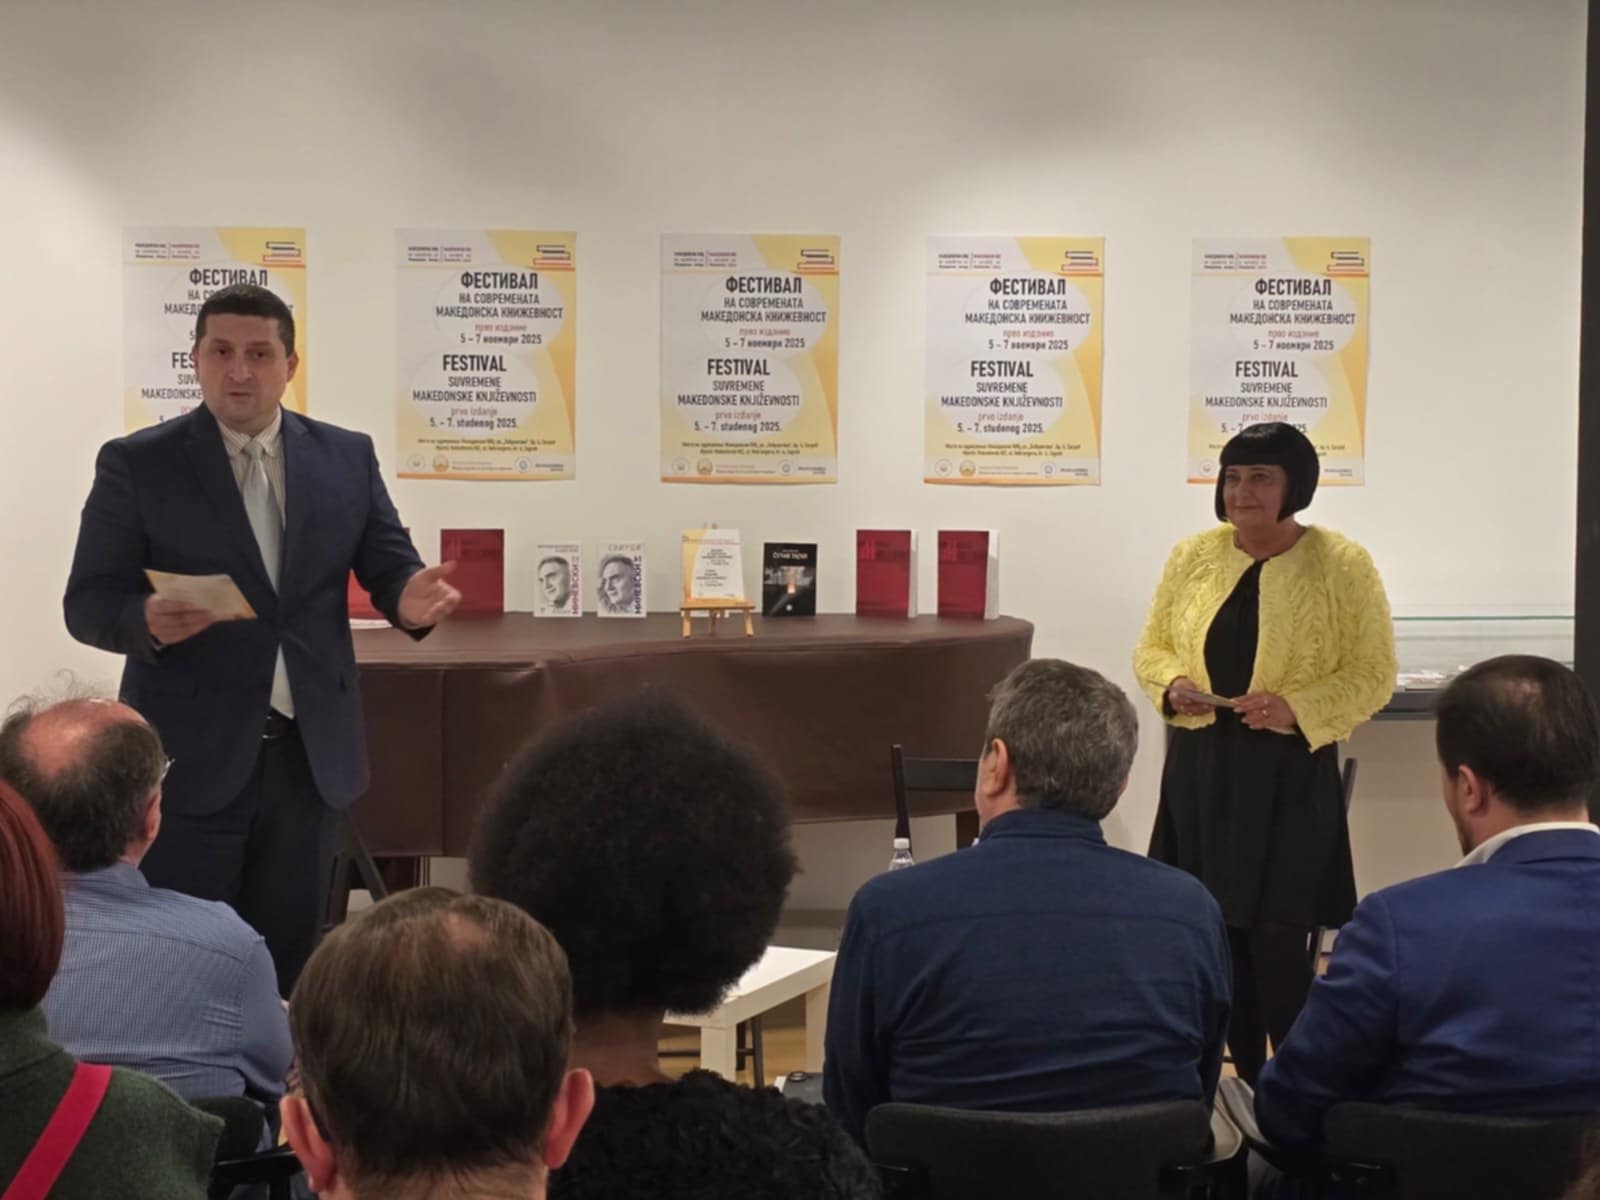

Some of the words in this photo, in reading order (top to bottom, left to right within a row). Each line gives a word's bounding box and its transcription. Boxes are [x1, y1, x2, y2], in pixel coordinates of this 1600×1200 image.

[190, 269, 268, 286] ФЕСТИВАЛ
[460, 272, 538, 289] ФЕСТИВАЛ
[726, 276, 802, 293] ФЕСТИВАЛ
[990, 278, 1066, 295] ФЕСТИВАЛ
[1255, 278, 1331, 295] ФЕСТИВАЛ
[188, 290, 200, 300] НА
[459, 293, 471, 303] НА
[474, 294, 539, 304] СОВРЕМЕНАТА
[724, 298, 736, 308] НА
[739, 298, 803, 309] СОВРЕМЕНАТА
[988, 300, 999, 310] НА
[1003, 300, 1067, 310] СОВРЕМЕНАТА
[1253, 300, 1265, 310] НА
[1268, 300, 1333, 311] СОВРЕМЕНАТА
[436, 306, 498, 319] МАКЕДОНСКА
[501, 307, 563, 319] КНИЖЕВНОСТ
[701, 311, 762, 323] МАКЕДОНСКА
[765, 311, 826, 323] КНИЖЕВНОСТ
[965, 313, 1026, 325] МАКЕДОНСКА
[1029, 313, 1090, 325] КНИЖЕВНОСТ
[1230, 313, 1291, 325] МАКЕДОНСКА
[1294, 313, 1355, 325] КНИЖЕВНОСТ
[460, 334, 465, 343] 5
[476, 334, 480, 344] 7
[483, 336, 518, 346] ноември
[521, 334, 542, 345] 2025
[725, 338, 730, 348] 5
[741, 338, 745, 348] 7
[748, 340, 782, 350] ноември
[784, 338, 805, 348] 2025
[988, 340, 993, 349] 5
[1004, 340, 1008, 350] 7
[1011, 342, 1045, 352] ноември
[1048, 340, 1068, 350] 2025
[1253, 340, 1259, 350] 5
[1269, 340, 1273, 350] 7
[1276, 342, 1310, 352] ноември
[1313, 340, 1334, 350] 2025
[443, 355, 507, 372] FESTIVAL
[708, 359, 770, 376] FESTIVAL
[971, 360, 1033, 377] FESTIVAL
[1236, 361, 1298, 378] FESTIVAL
[448, 377, 501, 387] SUVREMENE
[713, 381, 764, 392] SUVREMENE
[976, 382, 1028, 393] SUVREMENE
[1241, 382, 1292, 393] SUVREMENE
[142, 388, 202, 399] MAKEDONSKE
[413, 390, 473, 402] MAKEDONSKE
[475, 389, 536, 403] KNJIŽEVNOSTI
[678, 394, 737, 406] MAKEDONSKE
[740, 393, 800, 406] KNJIŽEVNOSTI
[942, 396, 1000, 407] MAKEDONSKE
[1002, 395, 1063, 408] KNJIŽEVNOSTI
[1206, 396, 1264, 408] MAKEDONSKE
[1267, 395, 1328, 408] KNJIŽEVNOSTI
[457, 418, 494, 430] studenog
[721, 421, 757, 434] studenog
[984, 423, 1020, 435] studenog
